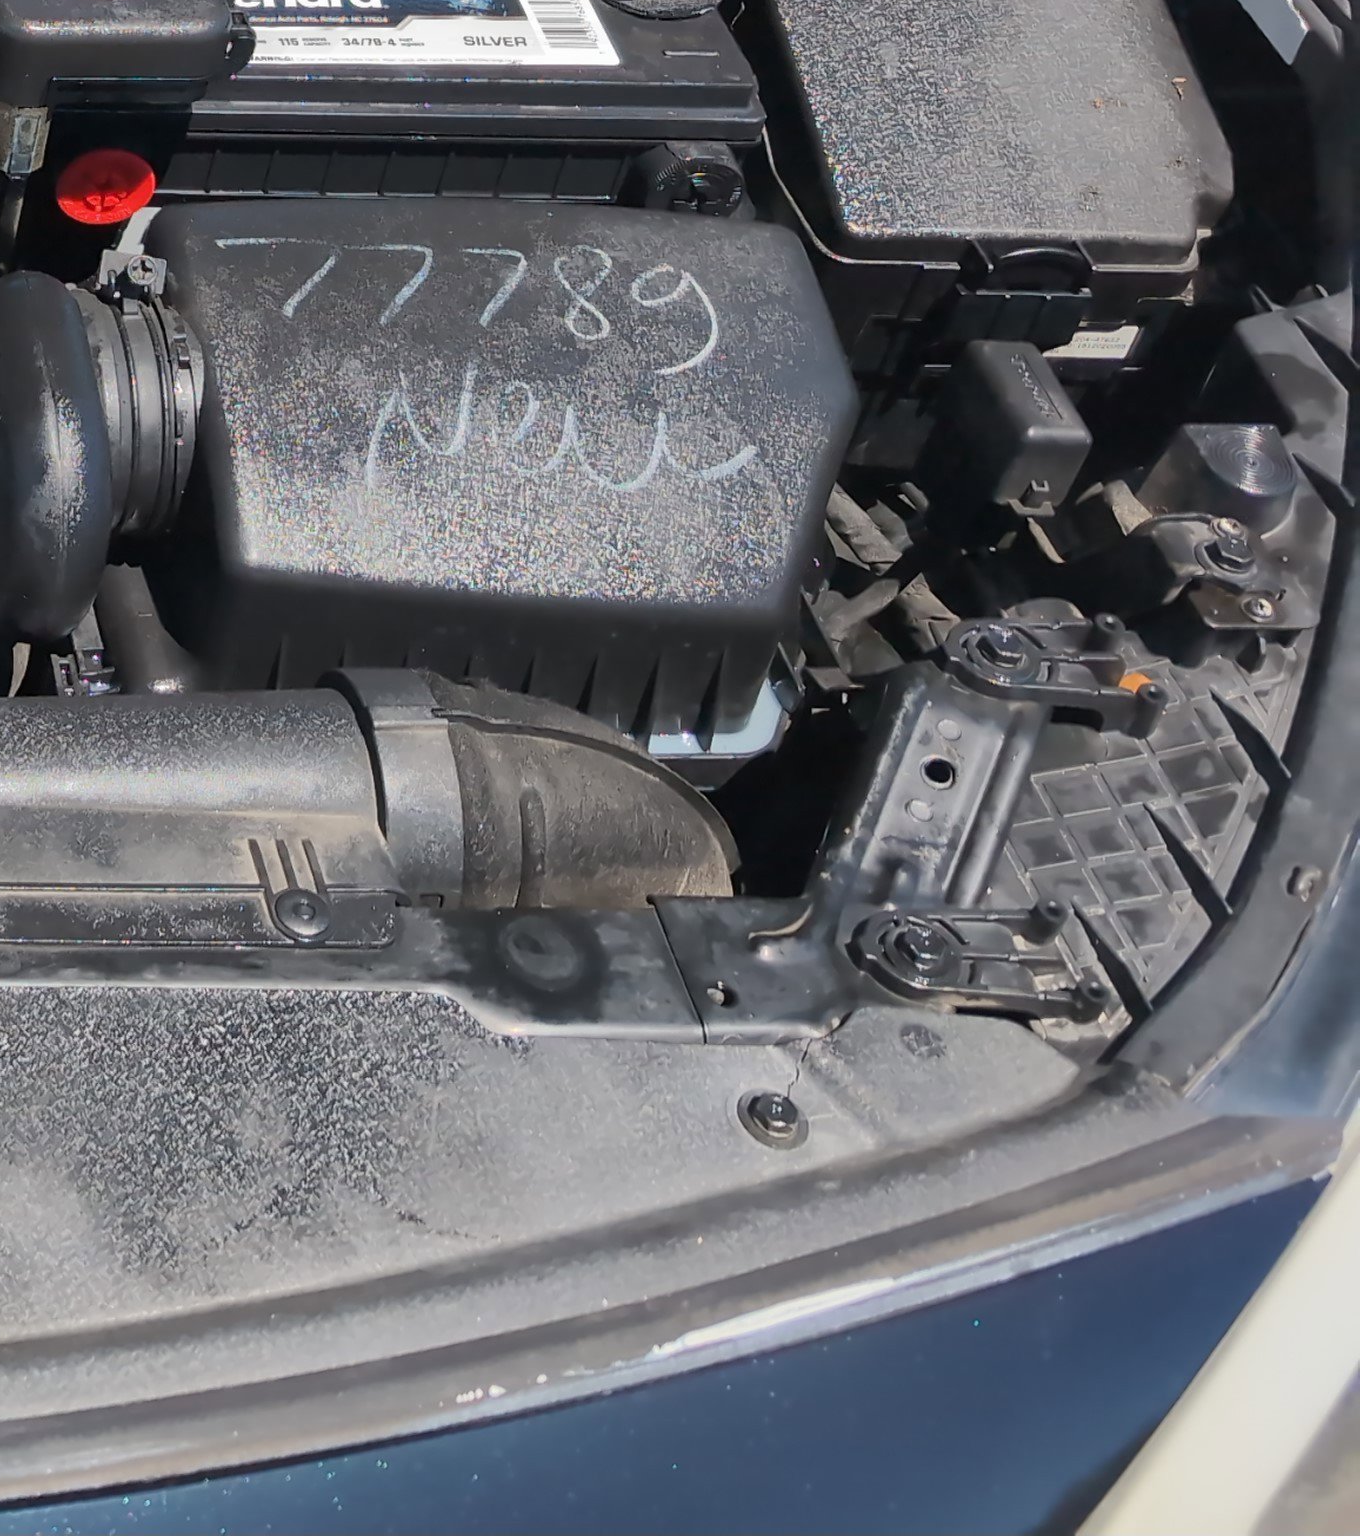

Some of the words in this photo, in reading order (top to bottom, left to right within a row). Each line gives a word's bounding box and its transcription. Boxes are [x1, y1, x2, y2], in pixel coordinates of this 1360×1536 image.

[278, 37, 299, 47] 115
[463, 35, 528, 47] SILVER
[214, 237, 719, 376] 77789
